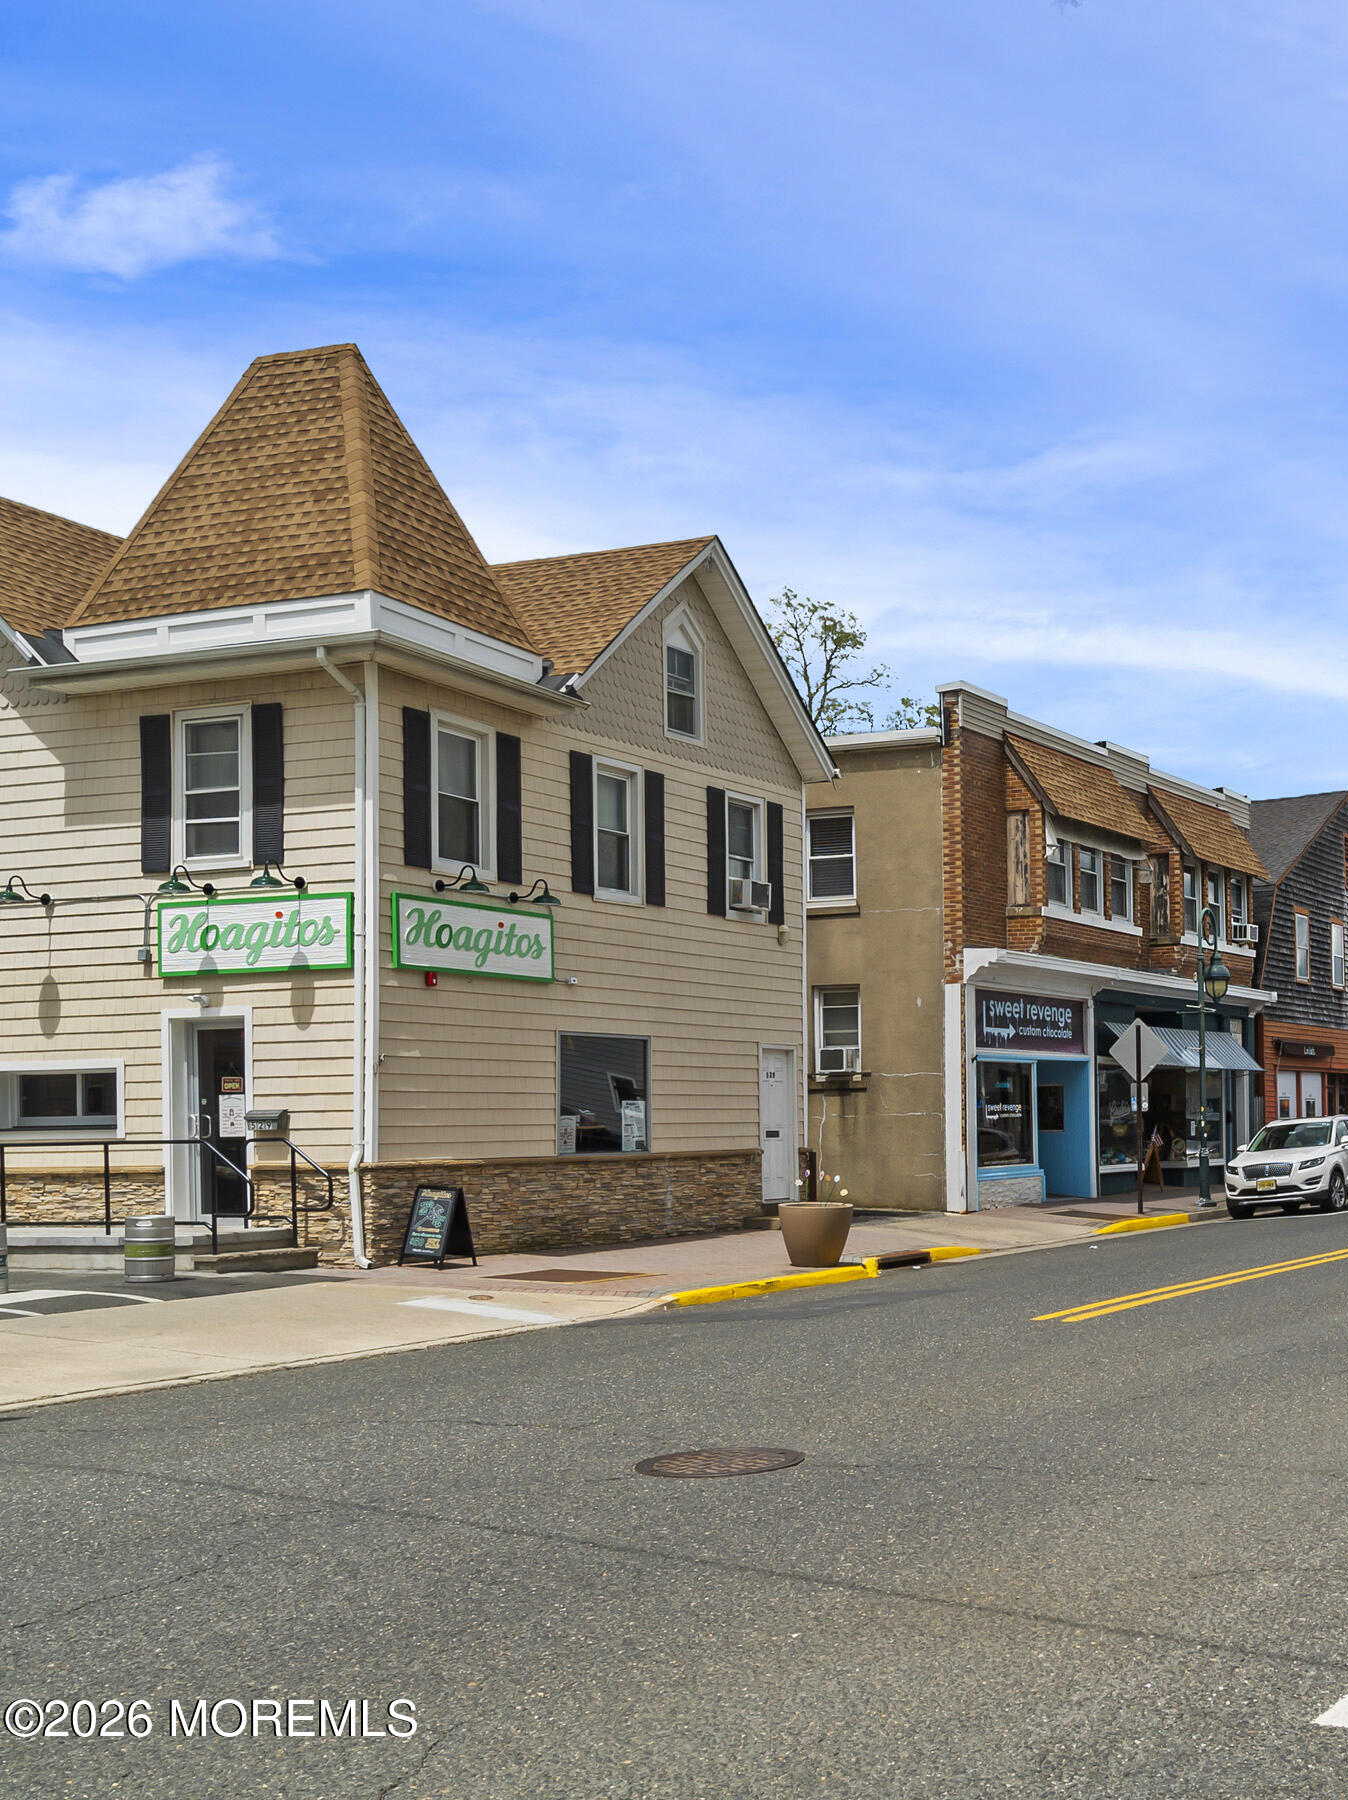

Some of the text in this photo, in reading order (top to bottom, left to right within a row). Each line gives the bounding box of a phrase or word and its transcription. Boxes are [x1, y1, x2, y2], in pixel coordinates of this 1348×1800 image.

[168, 910, 340, 966] Hoagitos
[405, 907, 547, 968] Hoagitos
[989, 998, 1072, 1027] sweet revenge
[1019, 1025, 1073, 1039] custom chocolate
[250, 1120, 272, 1130] 529
